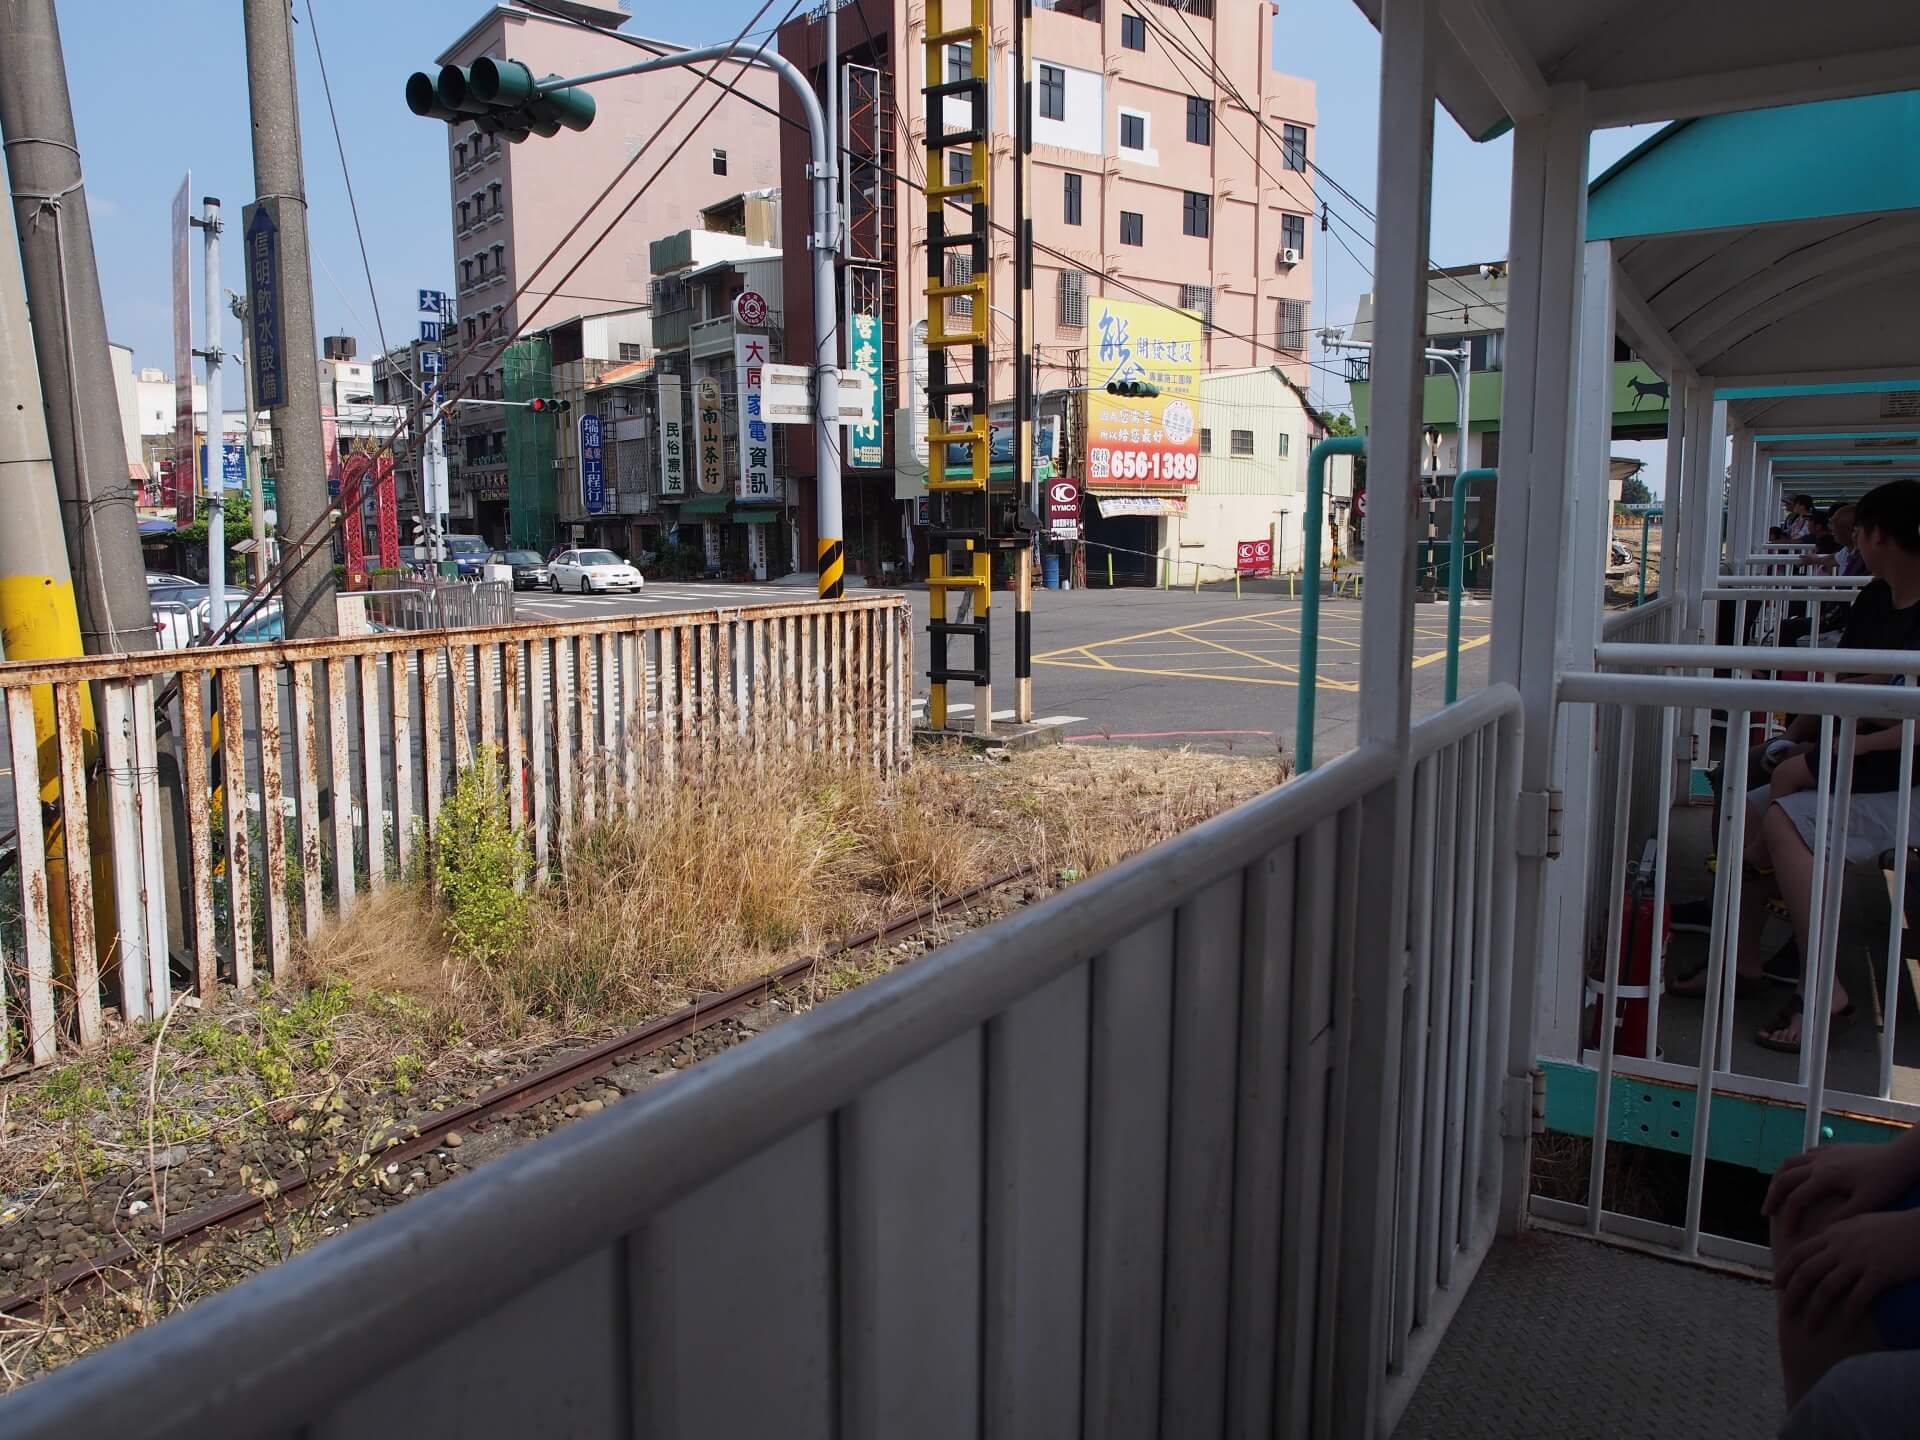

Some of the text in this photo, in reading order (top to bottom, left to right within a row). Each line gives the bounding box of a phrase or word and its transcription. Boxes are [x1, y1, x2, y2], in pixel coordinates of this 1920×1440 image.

[255, 231, 277, 400] 信明飲水設備
[703, 406, 720, 484] 南山茶行
[745, 341, 768, 494] 大同家電資訊
[667, 422, 681, 490] 民俗療法
[1111, 450, 1198, 481] 656-1389
[1051, 504, 1077, 512] KYMCO
